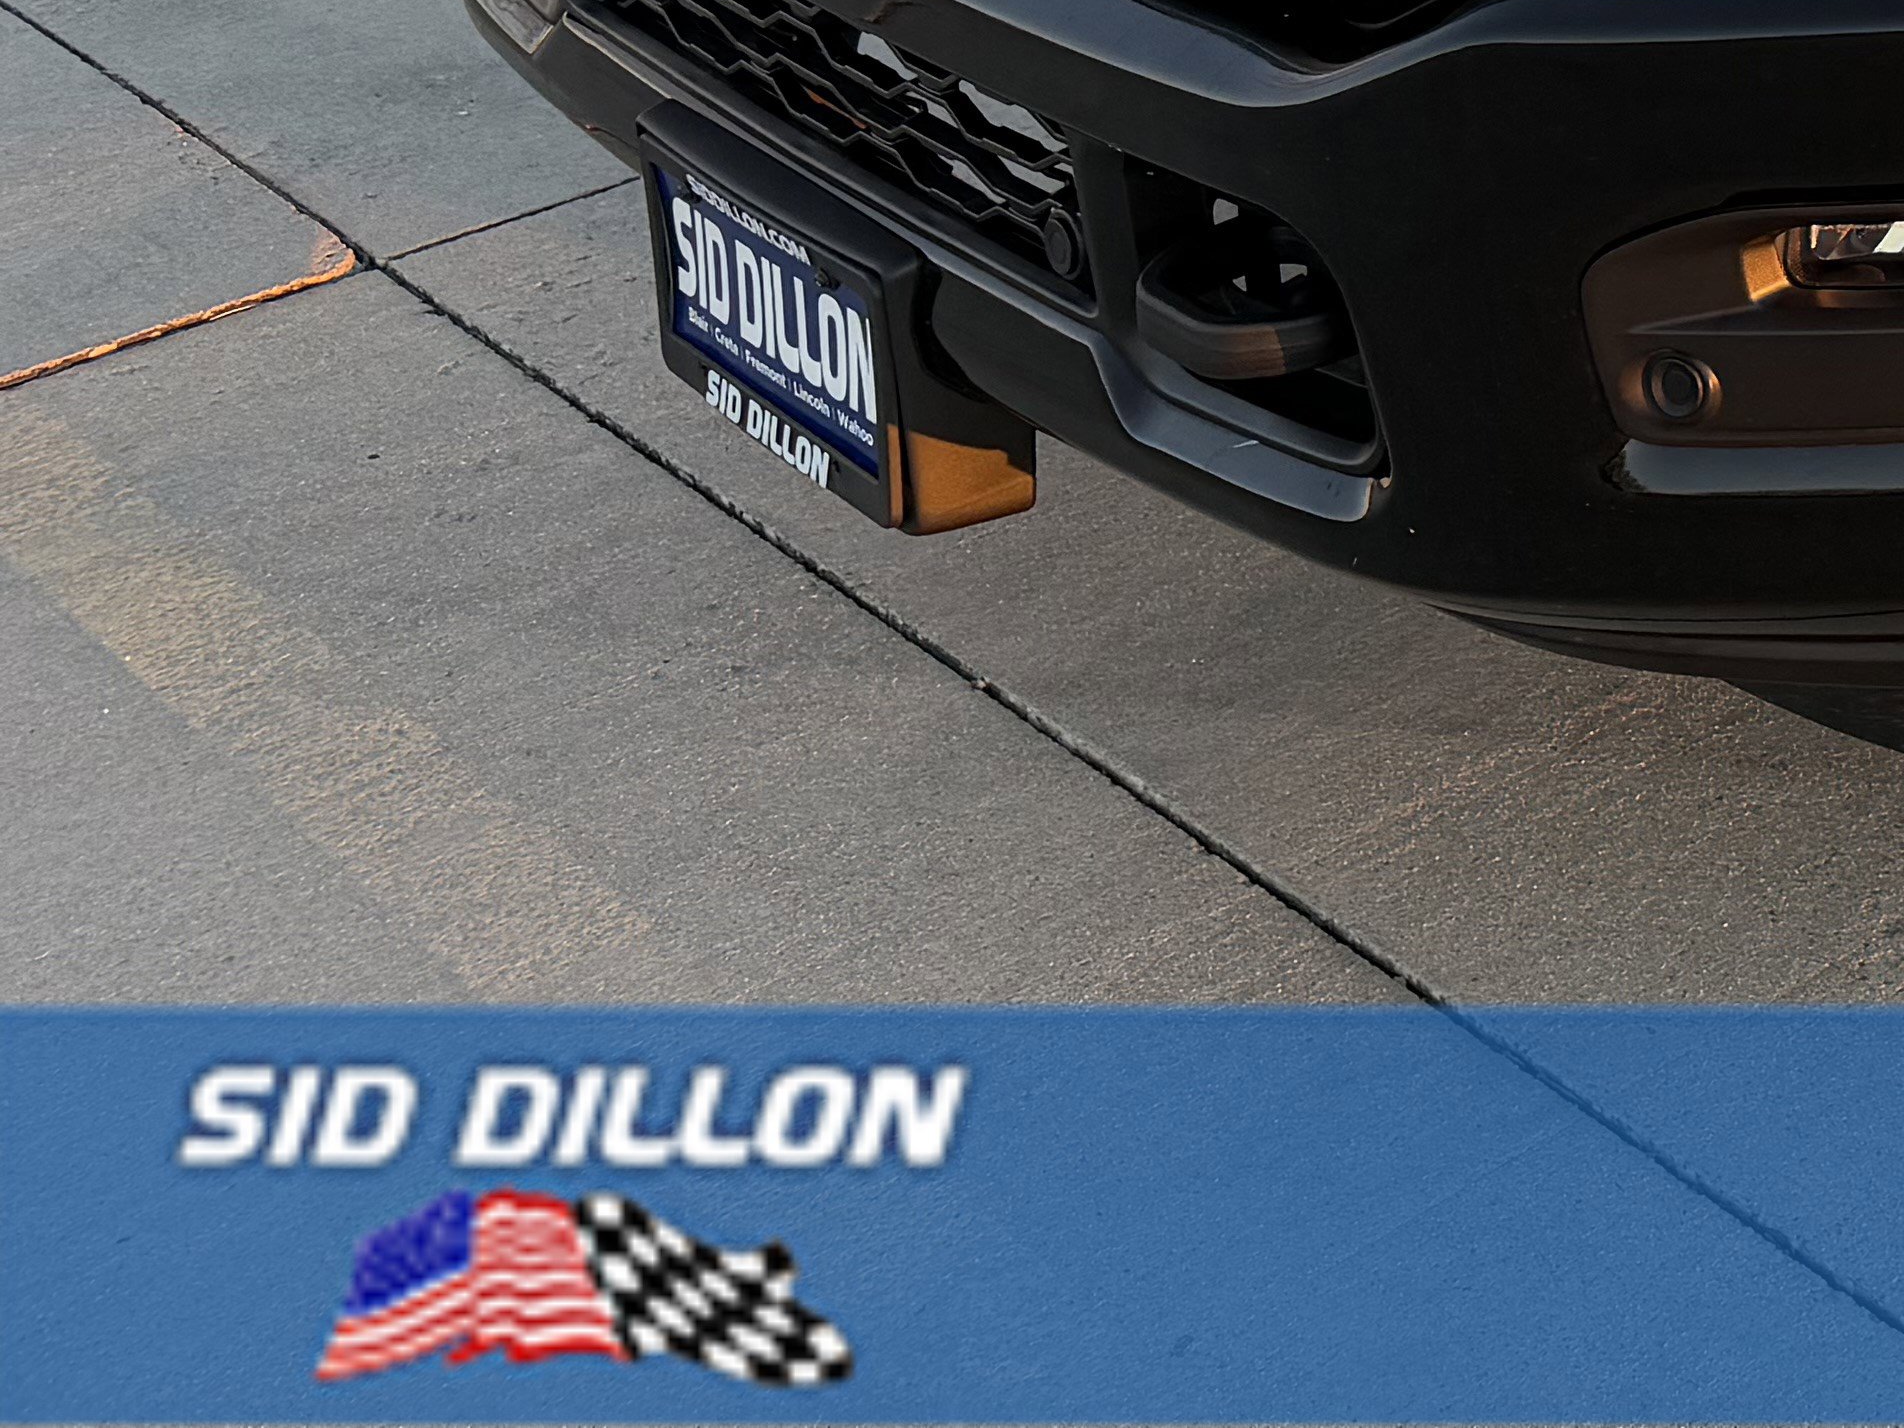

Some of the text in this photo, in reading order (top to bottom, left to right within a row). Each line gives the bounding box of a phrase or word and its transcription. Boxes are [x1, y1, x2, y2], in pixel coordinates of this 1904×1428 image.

[672, 197, 877, 426] SID DILLON
[705, 369, 831, 490] SID DILLON
[793, 381, 831, 418] Lincoln
[837, 408, 875, 447] Wahoo
